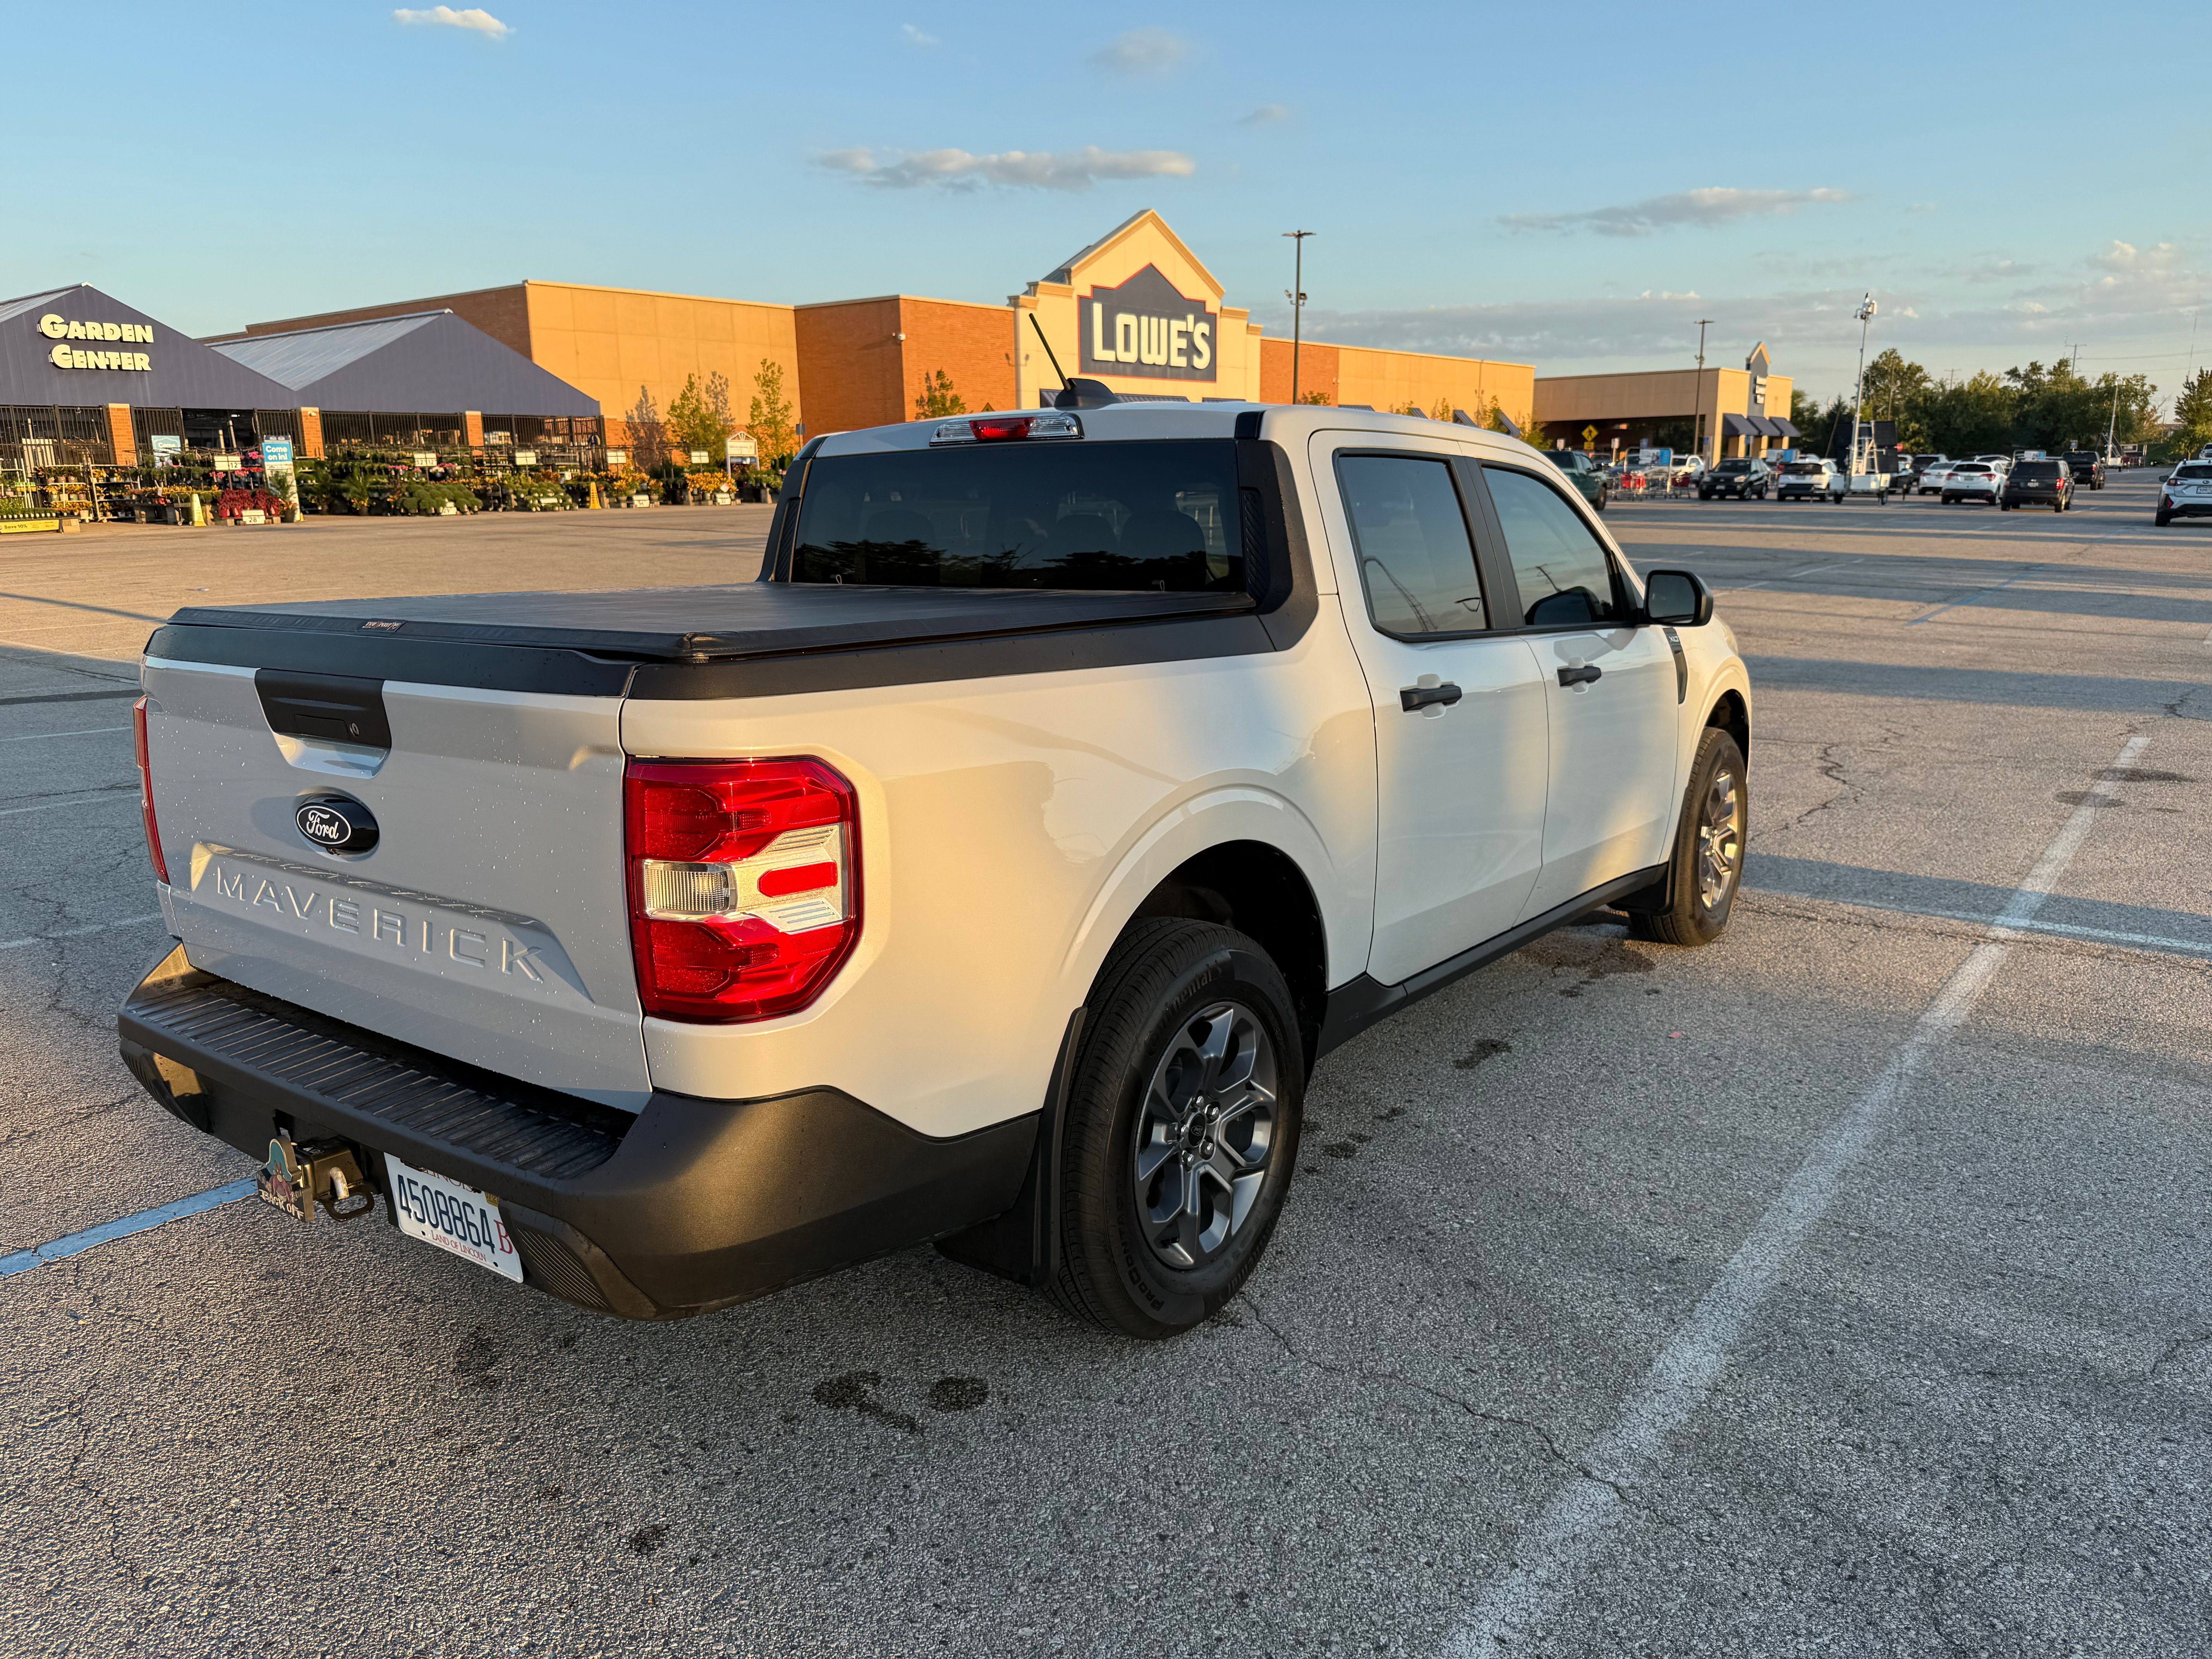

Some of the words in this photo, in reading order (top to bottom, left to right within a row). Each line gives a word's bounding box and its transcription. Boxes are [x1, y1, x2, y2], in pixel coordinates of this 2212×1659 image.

[40, 314, 154, 343] GARDEN
[1093, 302, 1211, 369] LOWE'S
[52, 344, 152, 371] CENTER
[306, 810, 339, 840] Ford
[217, 866, 543, 982] MAVERICK
[259, 1189, 286, 1211] BACK
[287, 1202, 304, 1221] OFF
[398, 1174, 495, 1254] 4508864
[494, 1219, 513, 1254] B
[431, 1230, 449, 1245] LAND
[450, 1240, 458, 1249] OF
[459, 1242, 487, 1262] LINCOLN
